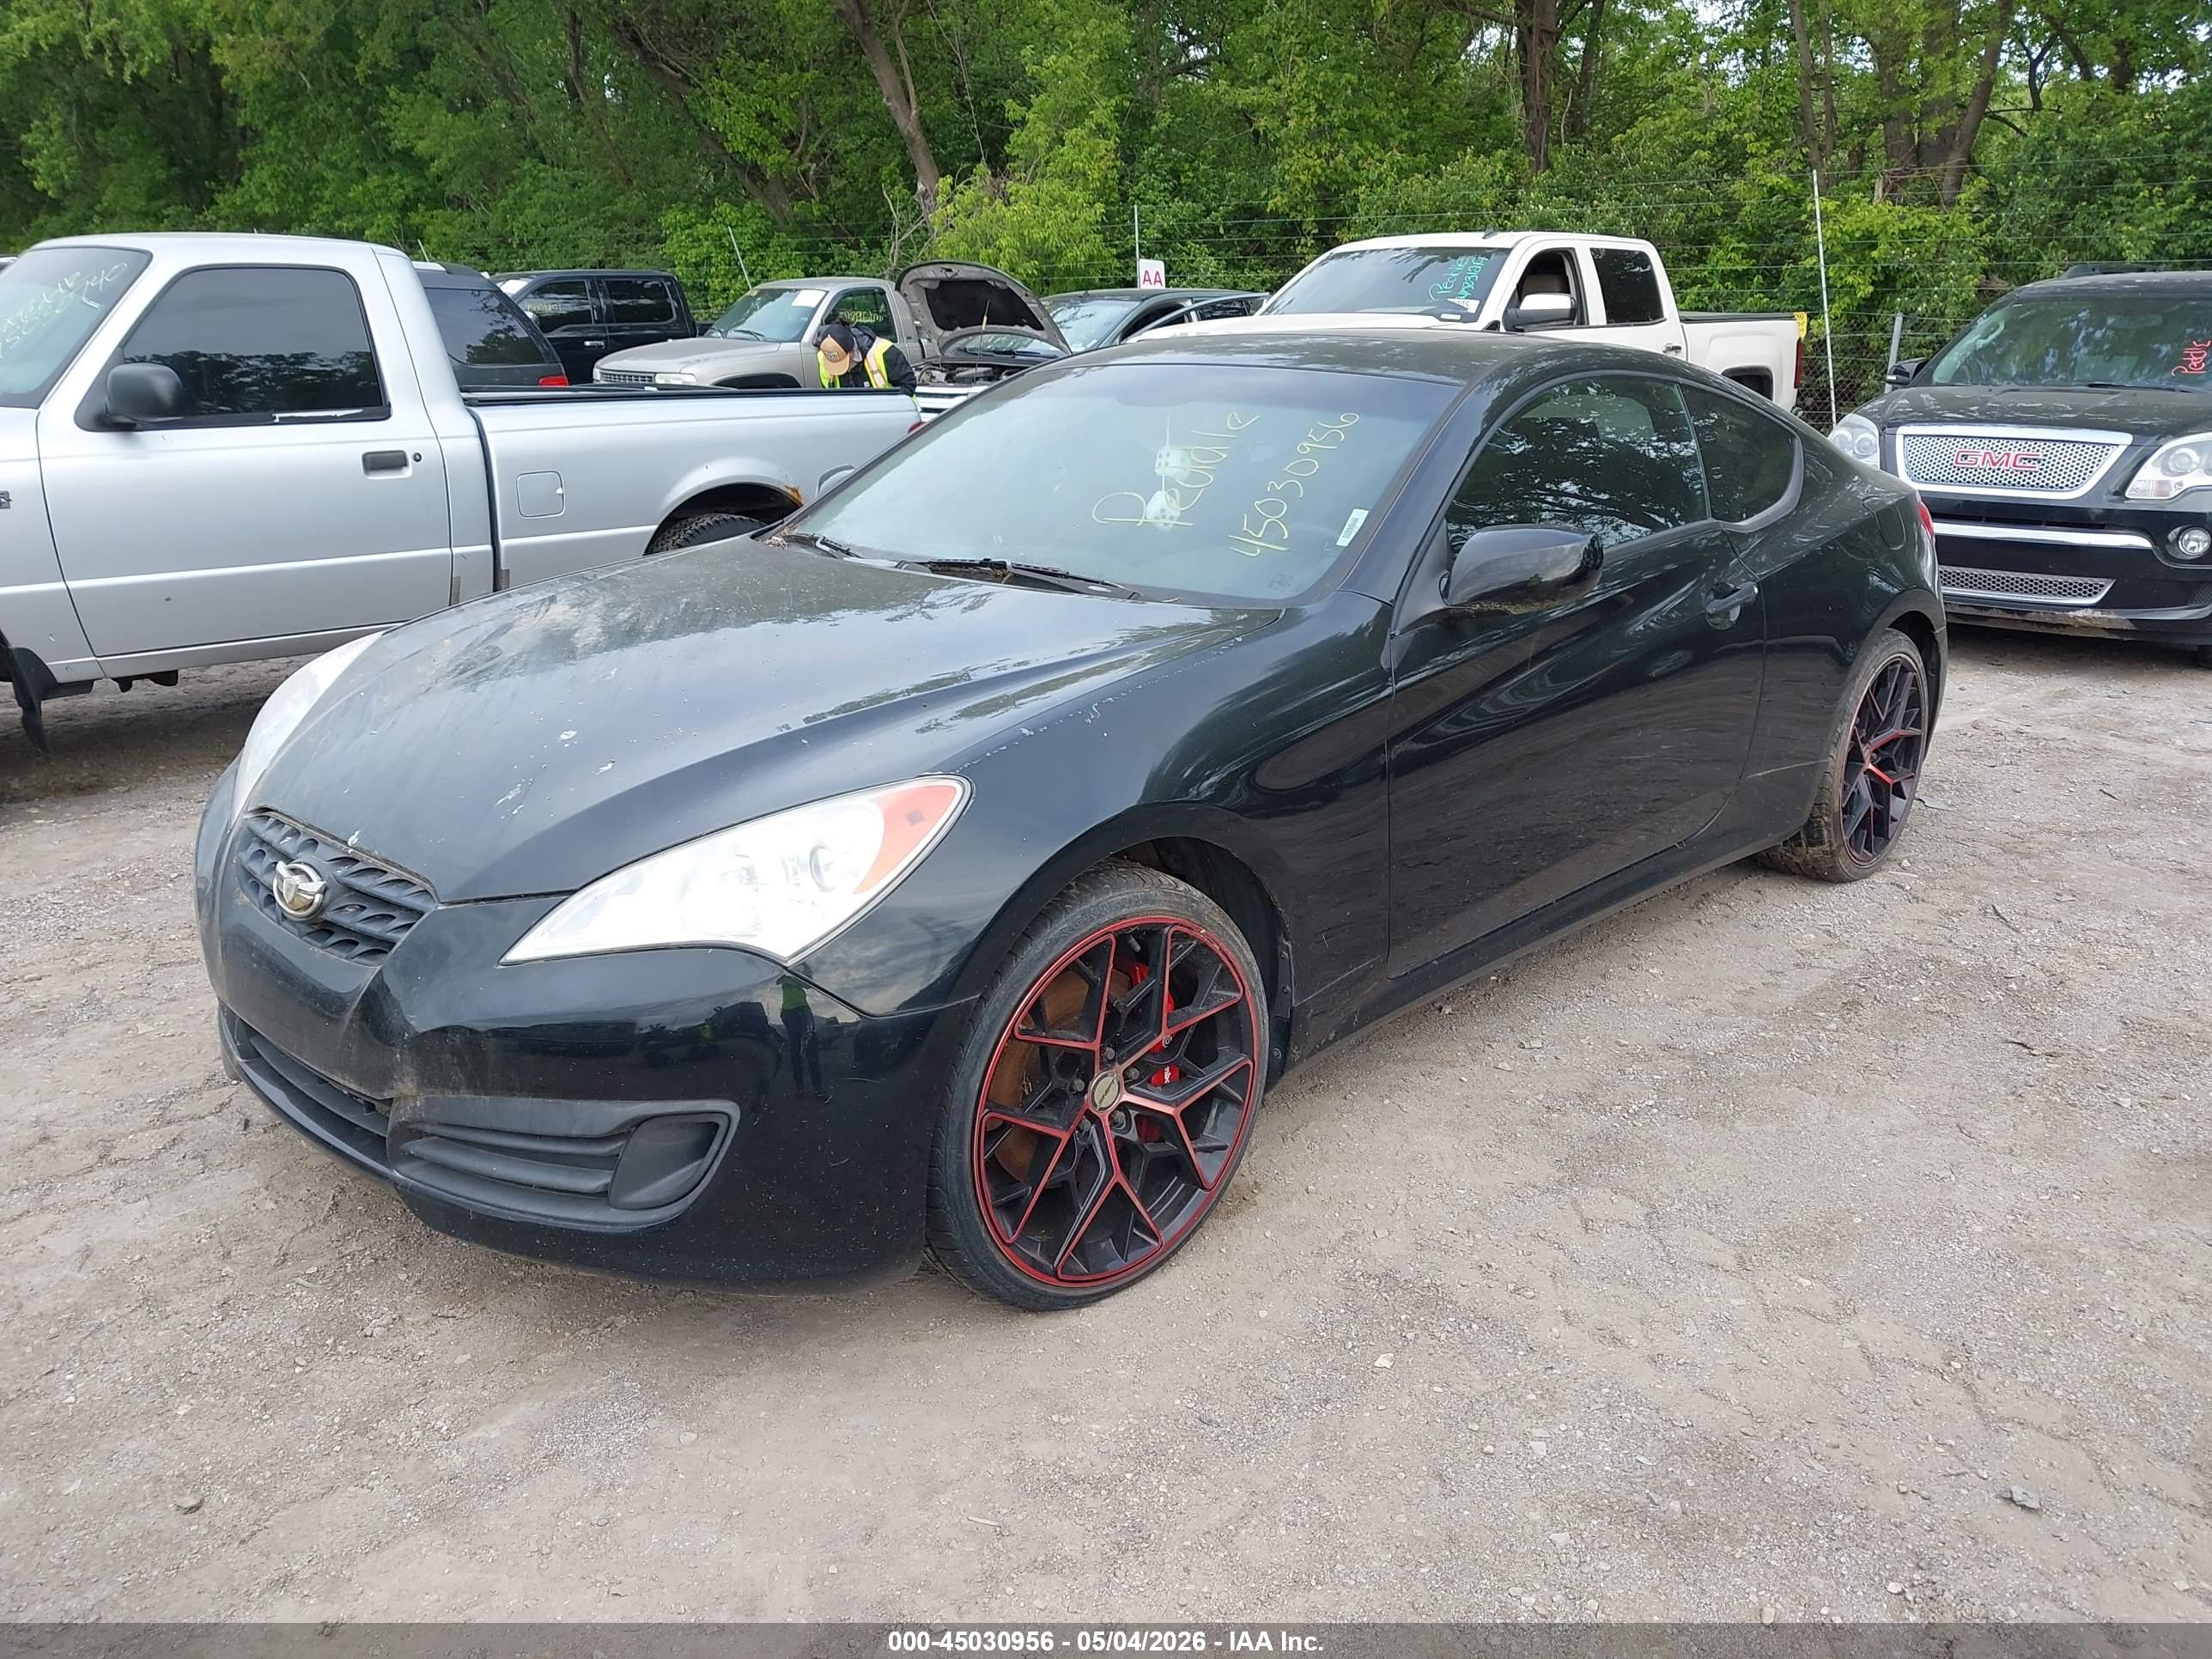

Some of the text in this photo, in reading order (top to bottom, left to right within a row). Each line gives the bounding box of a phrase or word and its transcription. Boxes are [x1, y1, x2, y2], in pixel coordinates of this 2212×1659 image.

[1143, 270, 1164, 287] AA
[2171, 340, 2212, 377] Peddle
[1954, 449, 2043, 471] GMC
[1227, 412, 1360, 557] 45030956
